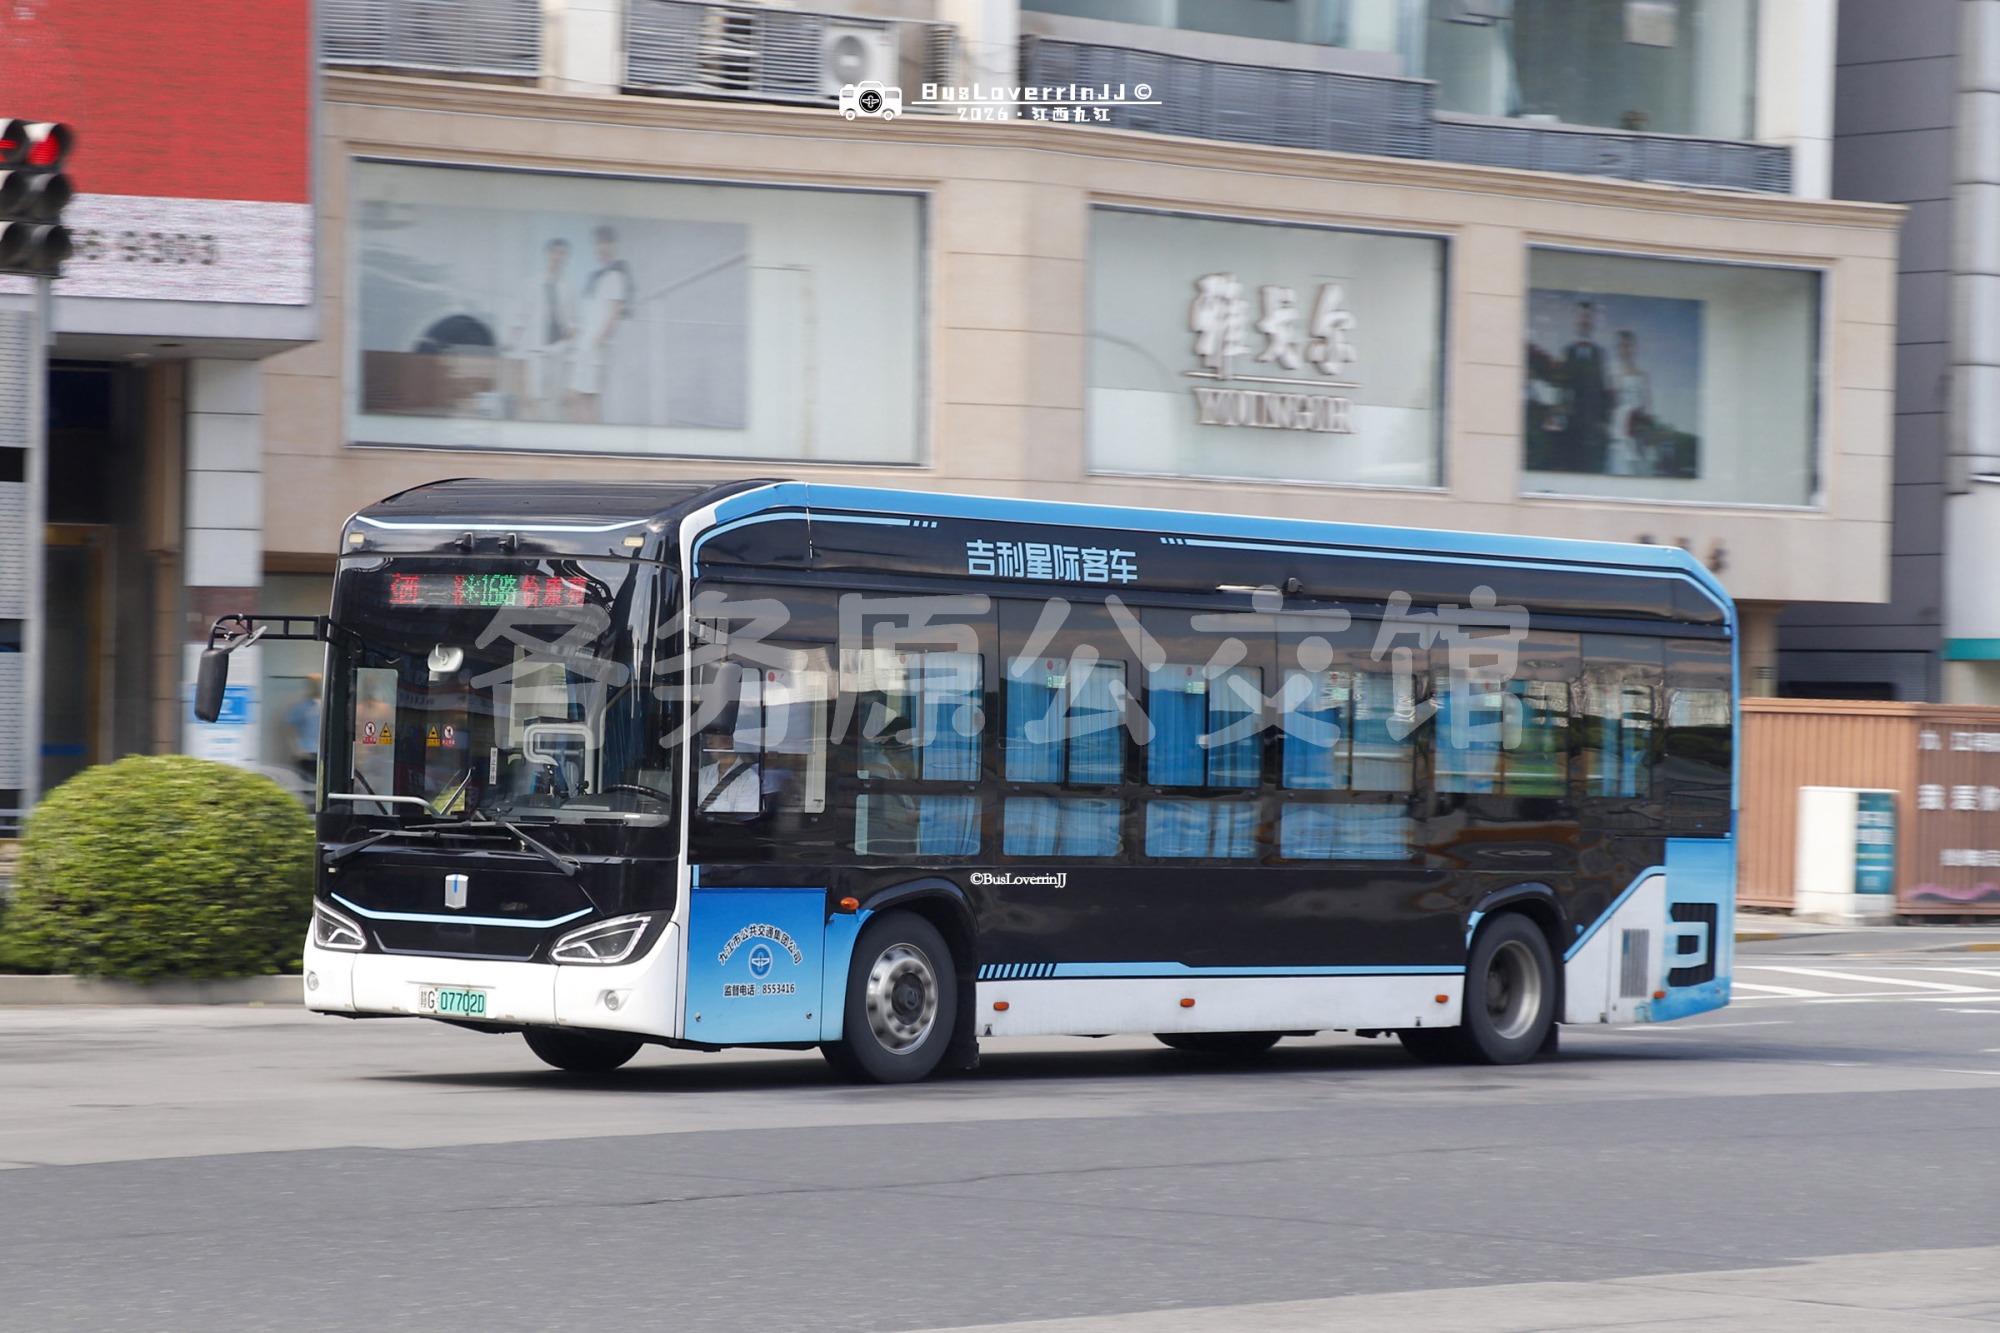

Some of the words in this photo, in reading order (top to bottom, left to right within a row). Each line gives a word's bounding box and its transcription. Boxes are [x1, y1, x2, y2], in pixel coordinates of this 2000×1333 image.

[966, 539, 1138, 584] 吉利星际客车
[719, 924, 802, 965] 九江市公共交通集团公司
[441, 991, 485, 1013] 07702D
